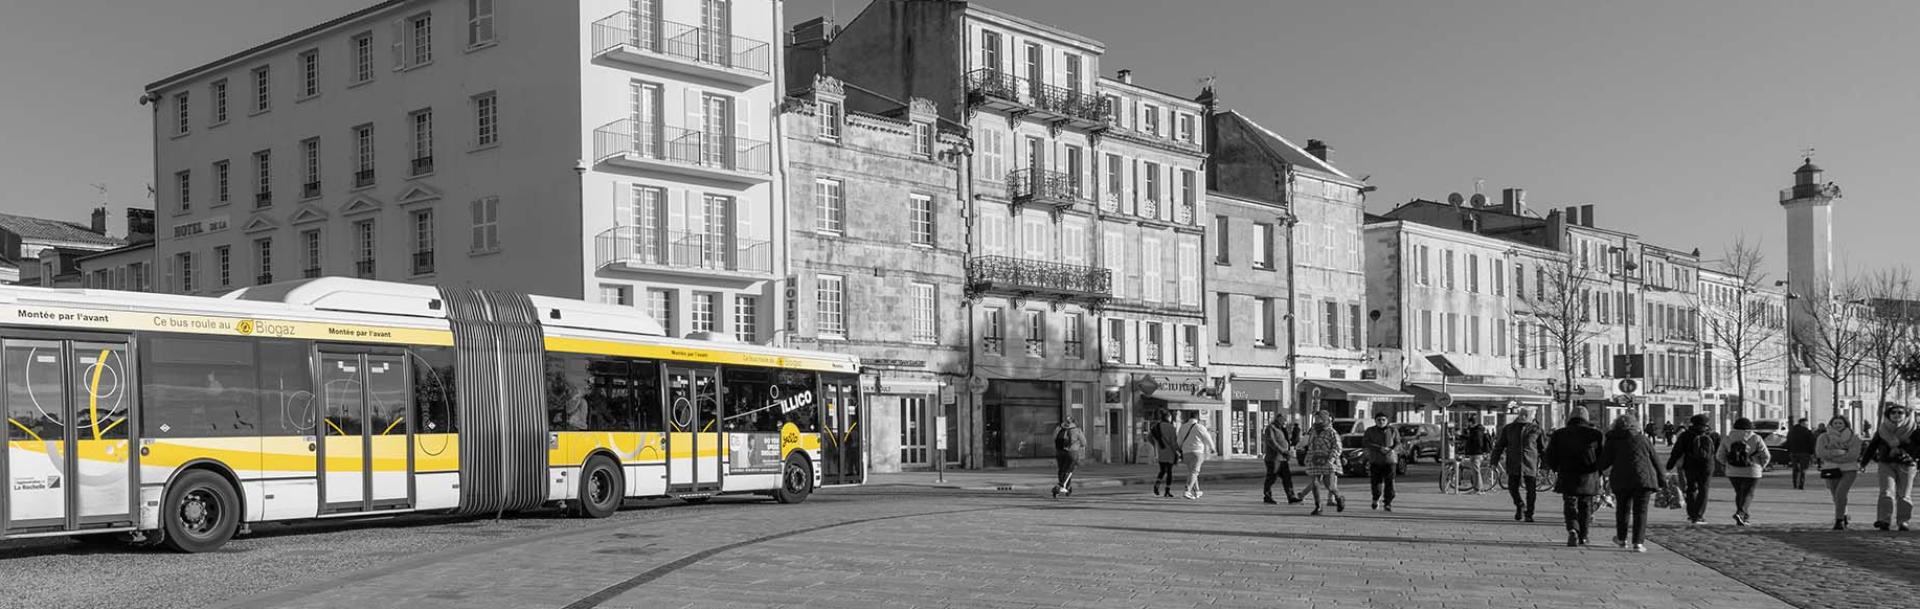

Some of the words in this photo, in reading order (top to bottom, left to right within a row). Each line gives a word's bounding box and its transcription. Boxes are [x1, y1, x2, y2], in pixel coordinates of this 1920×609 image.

[174, 221, 203, 238] HOTEL
[786, 277, 796, 332] HOTEL
[18, 309, 55, 319] Montée
[58, 313, 74, 321] par
[77, 313, 109, 323] l'avant
[154, 316, 167, 327] Ce
[170, 317, 188, 328] bus
[191, 318, 216, 329] roule
[219, 321, 231, 330] au
[256, 320, 296, 337] Biogaz
[328, 327, 355, 336] Montée
[356, 329, 367, 337] par
[369, 330, 392, 338] l'avant
[780, 390, 812, 414] ILLICO
